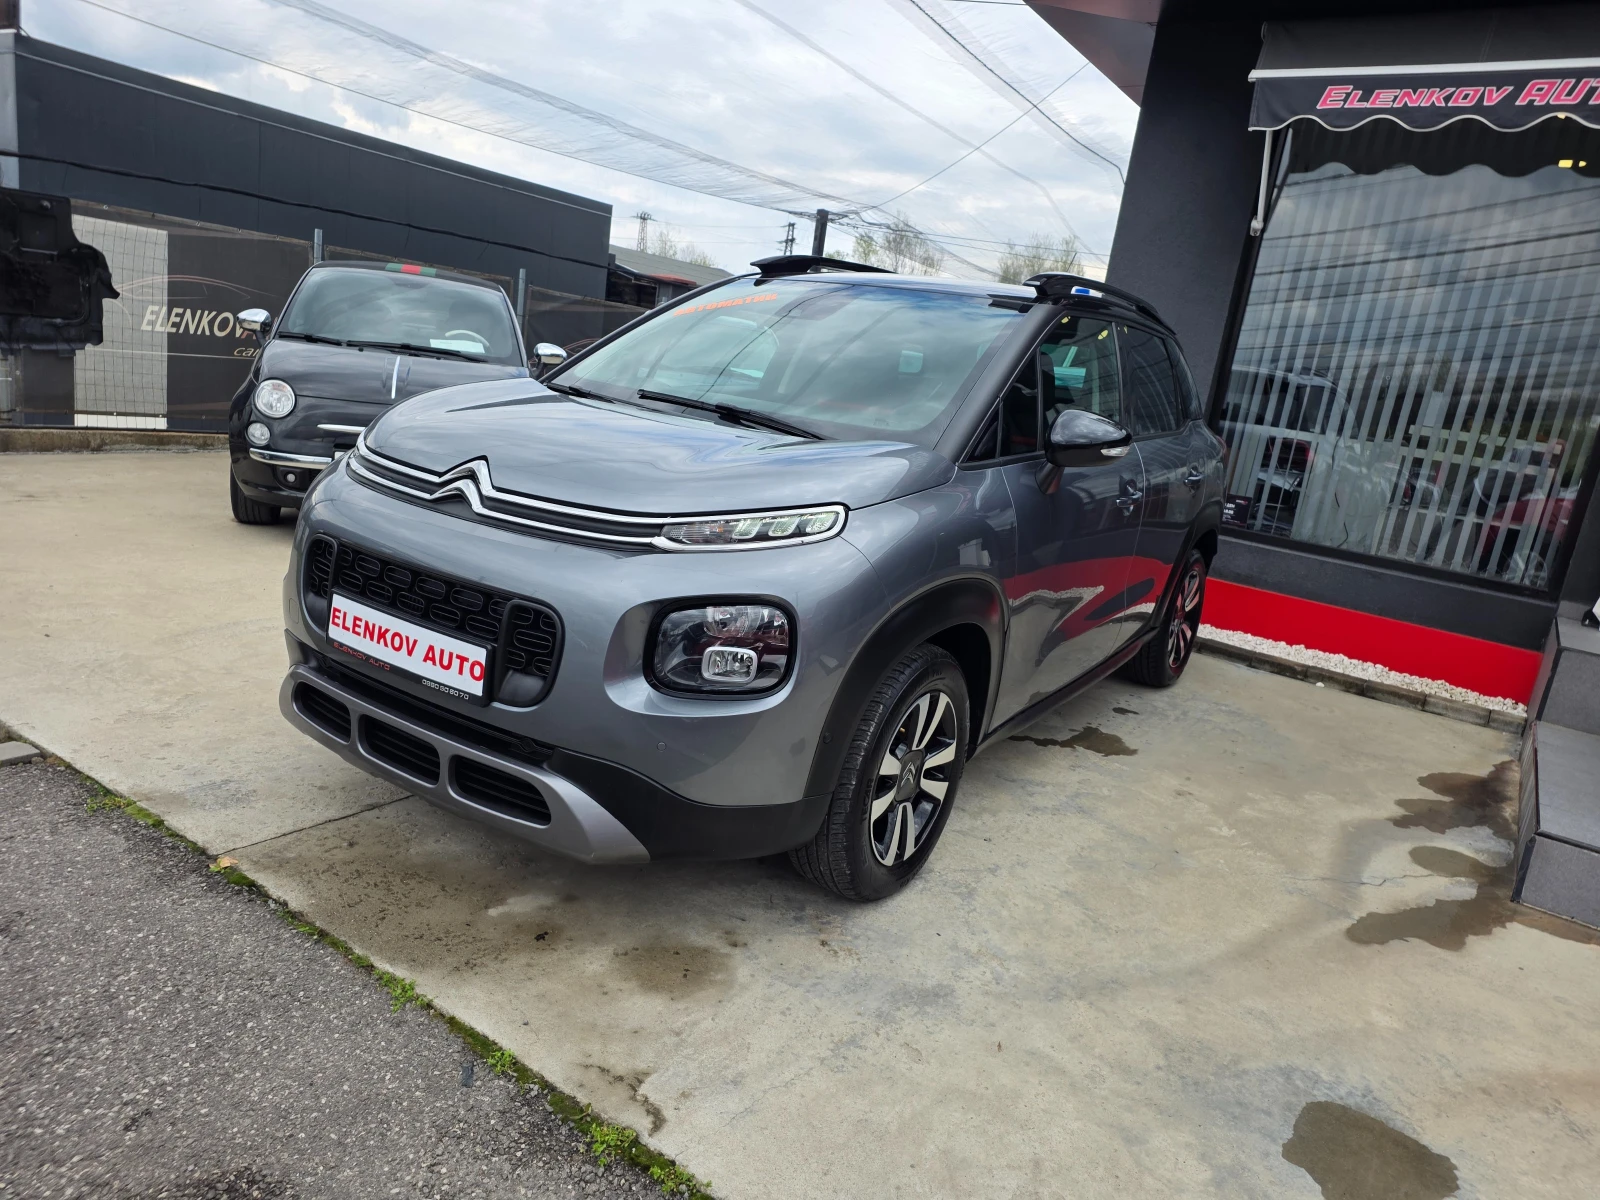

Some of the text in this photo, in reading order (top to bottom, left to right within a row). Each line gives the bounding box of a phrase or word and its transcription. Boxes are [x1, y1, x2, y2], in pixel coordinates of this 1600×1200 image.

[330, 606, 485, 682] ELENKOV AUTO
[333, 641, 390, 670] ELENKOV AUTO
